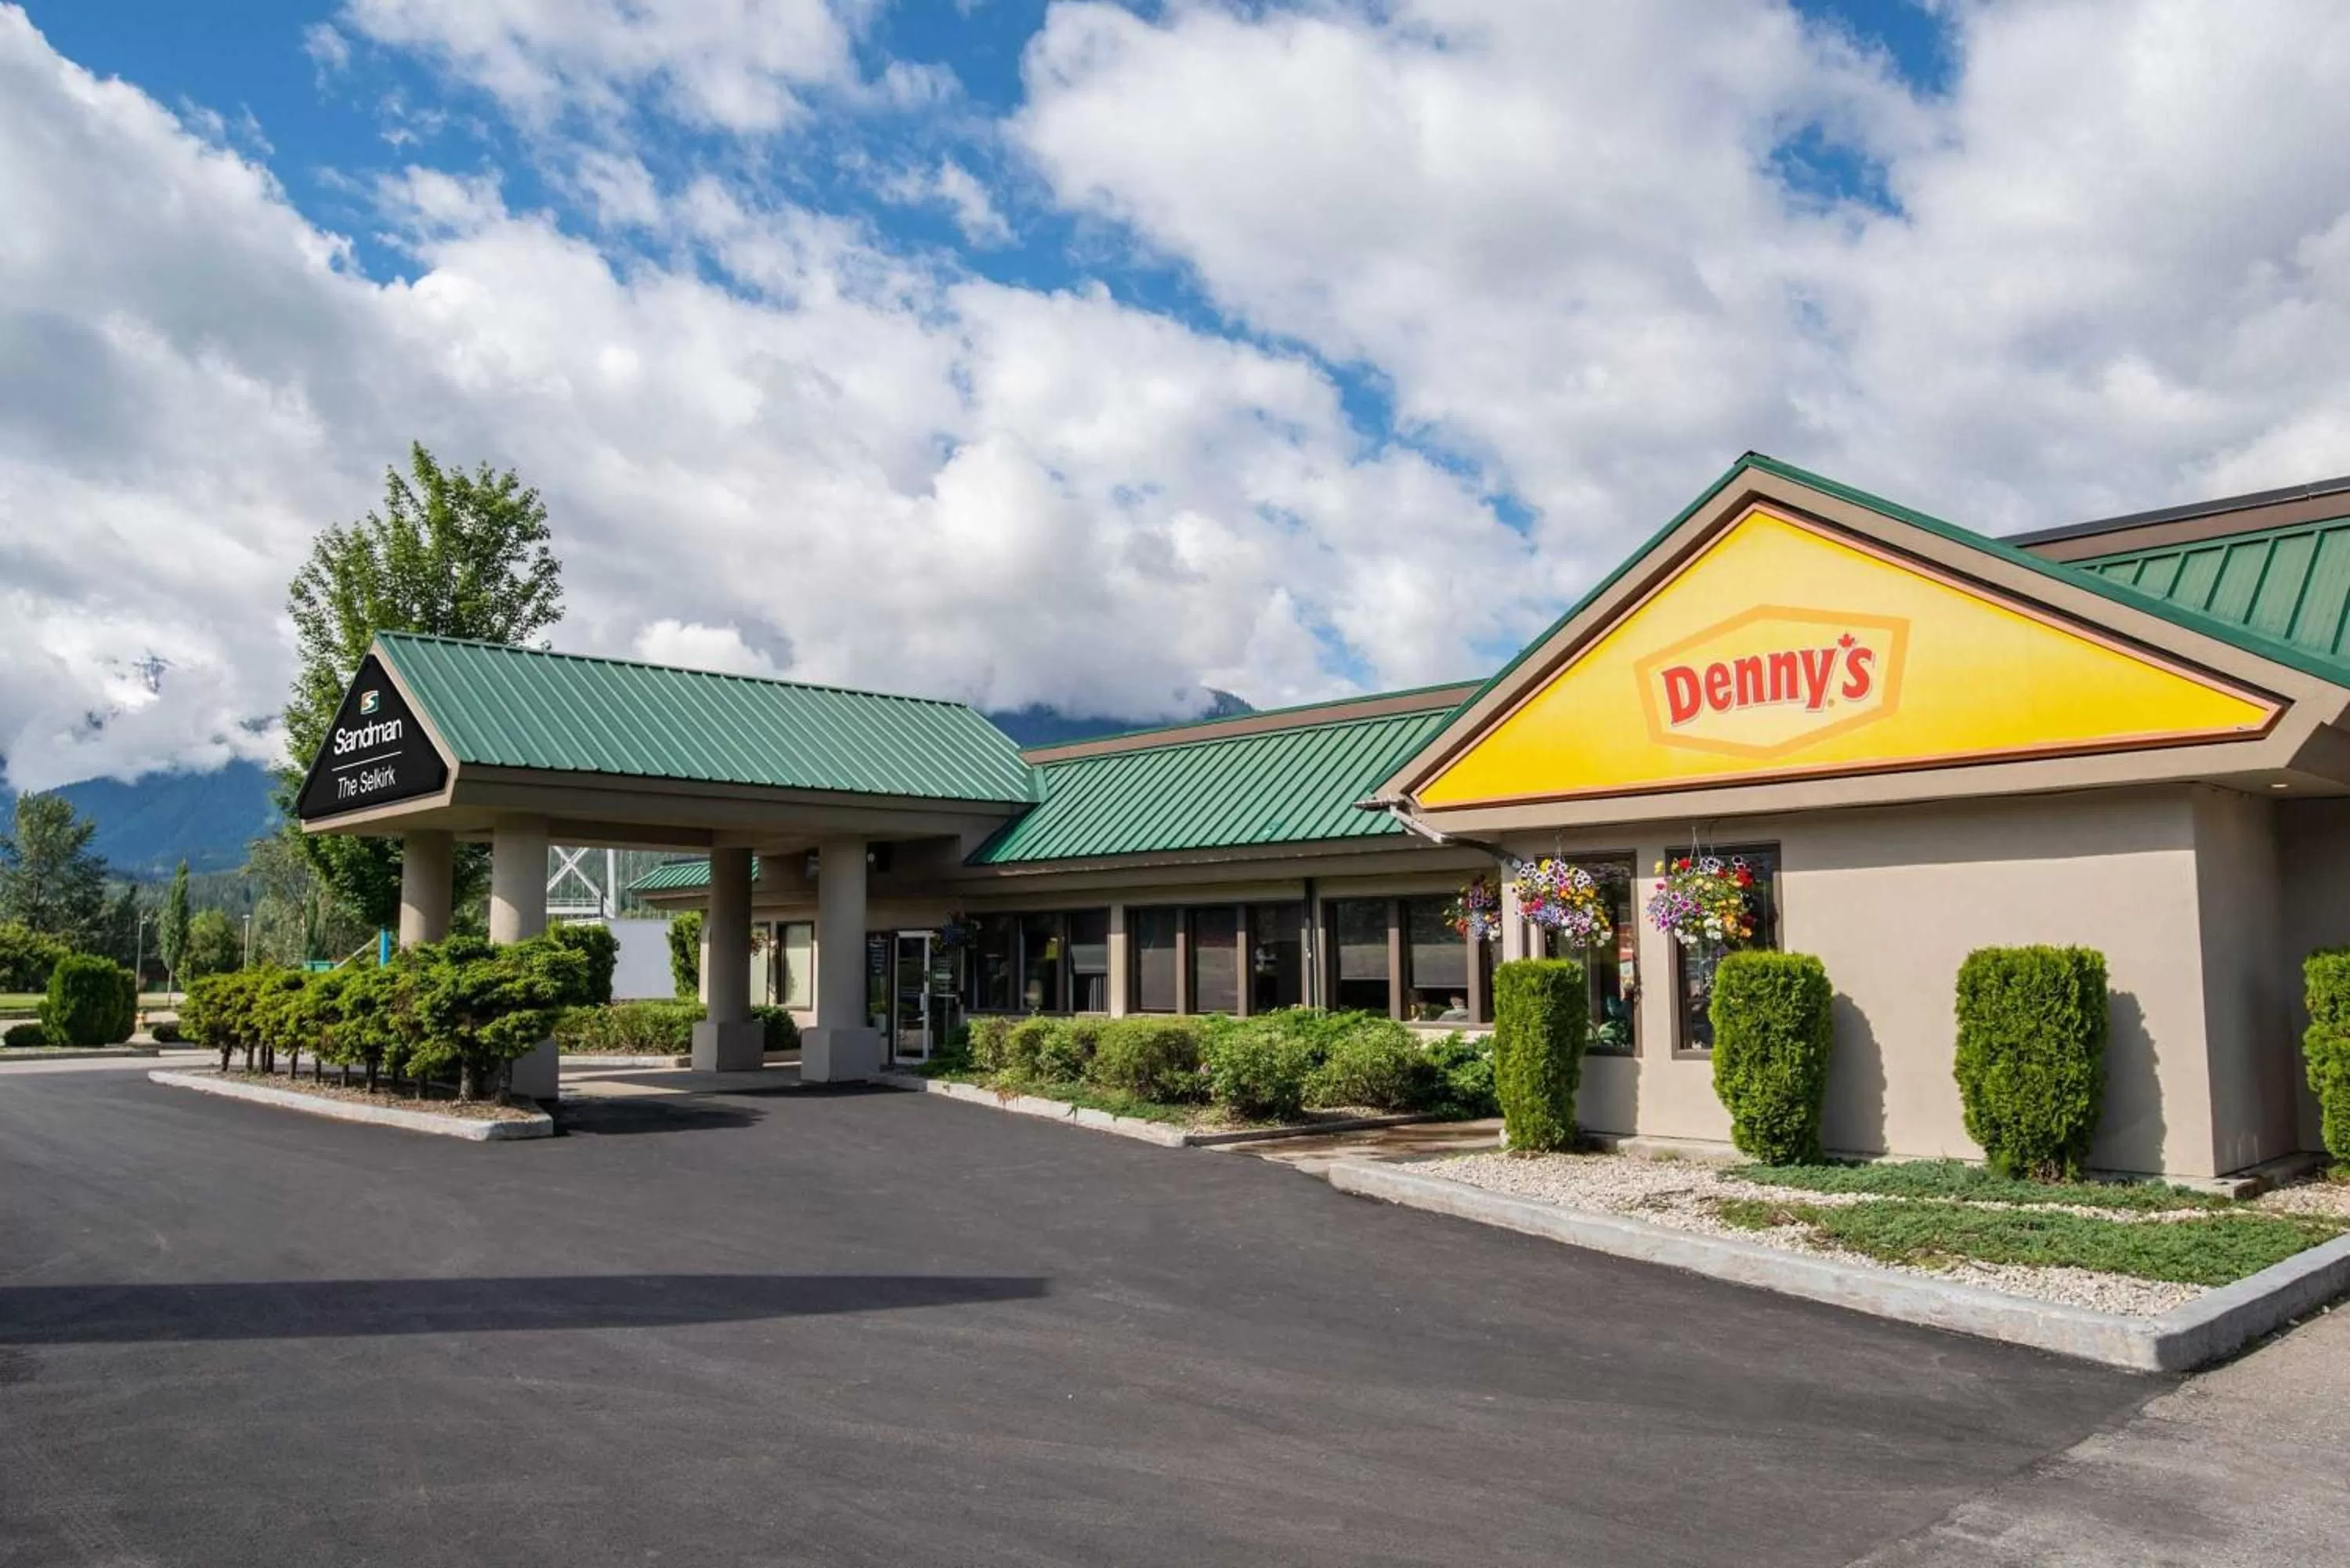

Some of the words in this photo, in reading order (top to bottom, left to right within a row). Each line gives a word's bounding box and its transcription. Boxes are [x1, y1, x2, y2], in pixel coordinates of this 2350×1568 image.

[1661, 633, 1873, 725] Denny's
[334, 719, 402, 754] Sandman
[338, 777, 357, 799] The
[360, 765, 396, 793] Selkirk
